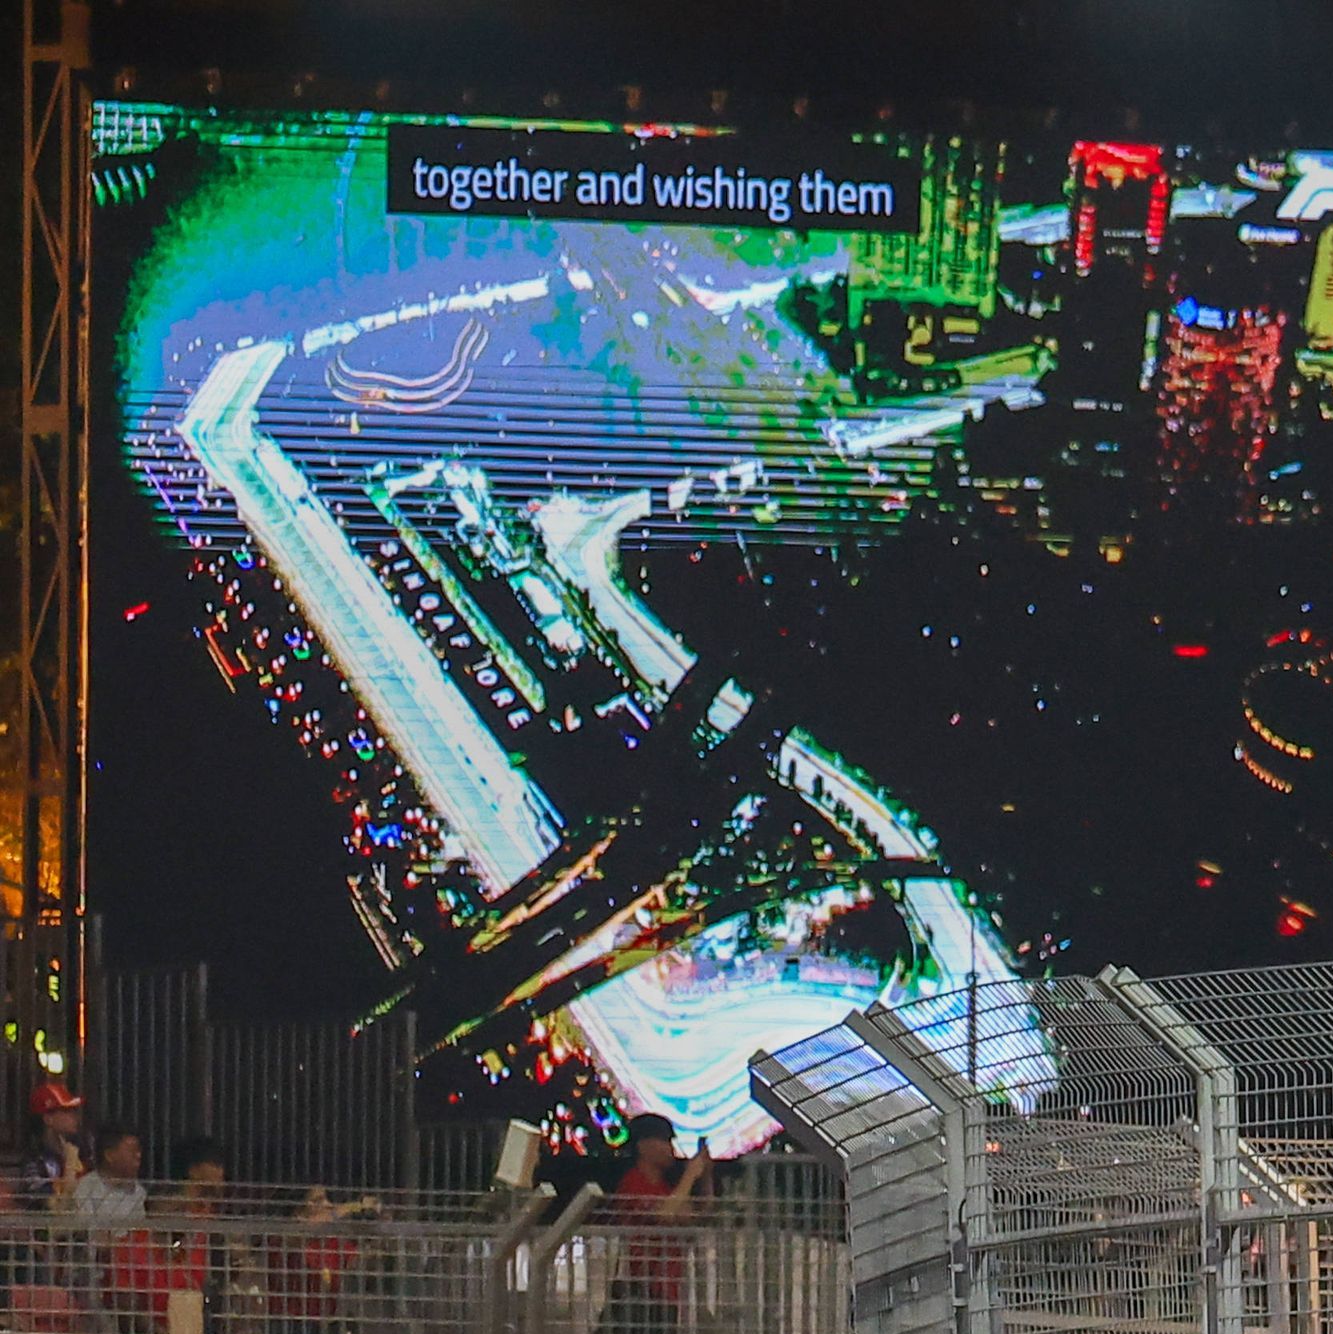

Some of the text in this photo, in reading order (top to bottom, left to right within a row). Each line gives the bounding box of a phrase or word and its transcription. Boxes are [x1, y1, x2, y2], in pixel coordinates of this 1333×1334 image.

[412, 157, 895, 224] together and wishing them
